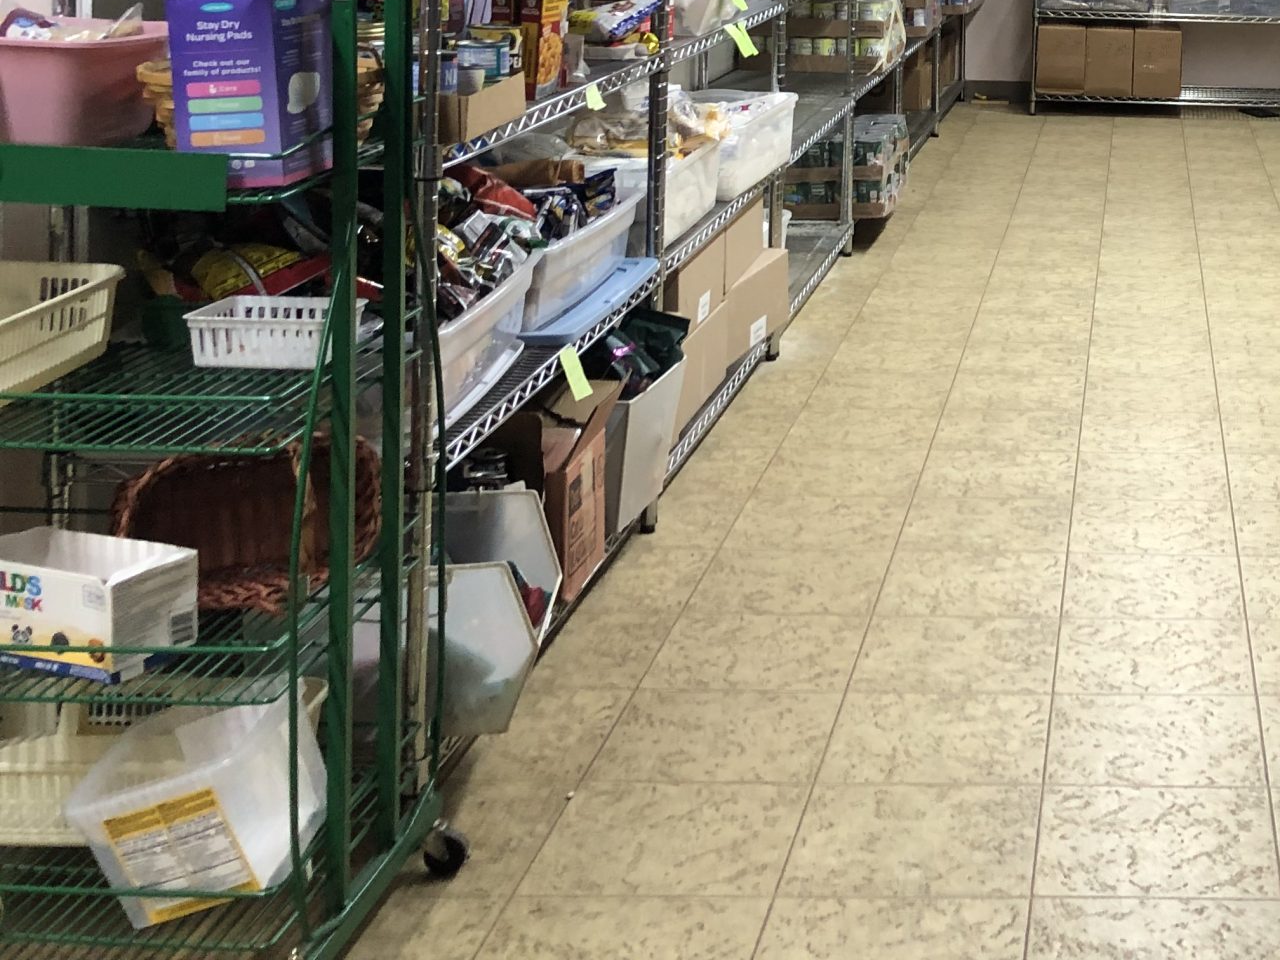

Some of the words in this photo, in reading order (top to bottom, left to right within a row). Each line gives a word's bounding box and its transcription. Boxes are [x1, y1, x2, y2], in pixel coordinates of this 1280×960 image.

[196, 21, 219, 31] Stay
[220, 19, 241, 30] Dry
[186, 32, 227, 42] Nursing
[227, 30, 253, 40] Pads
[193, 60, 218, 68] Check
[184, 69, 209, 77] family
[221, 66, 262, 76] products!
